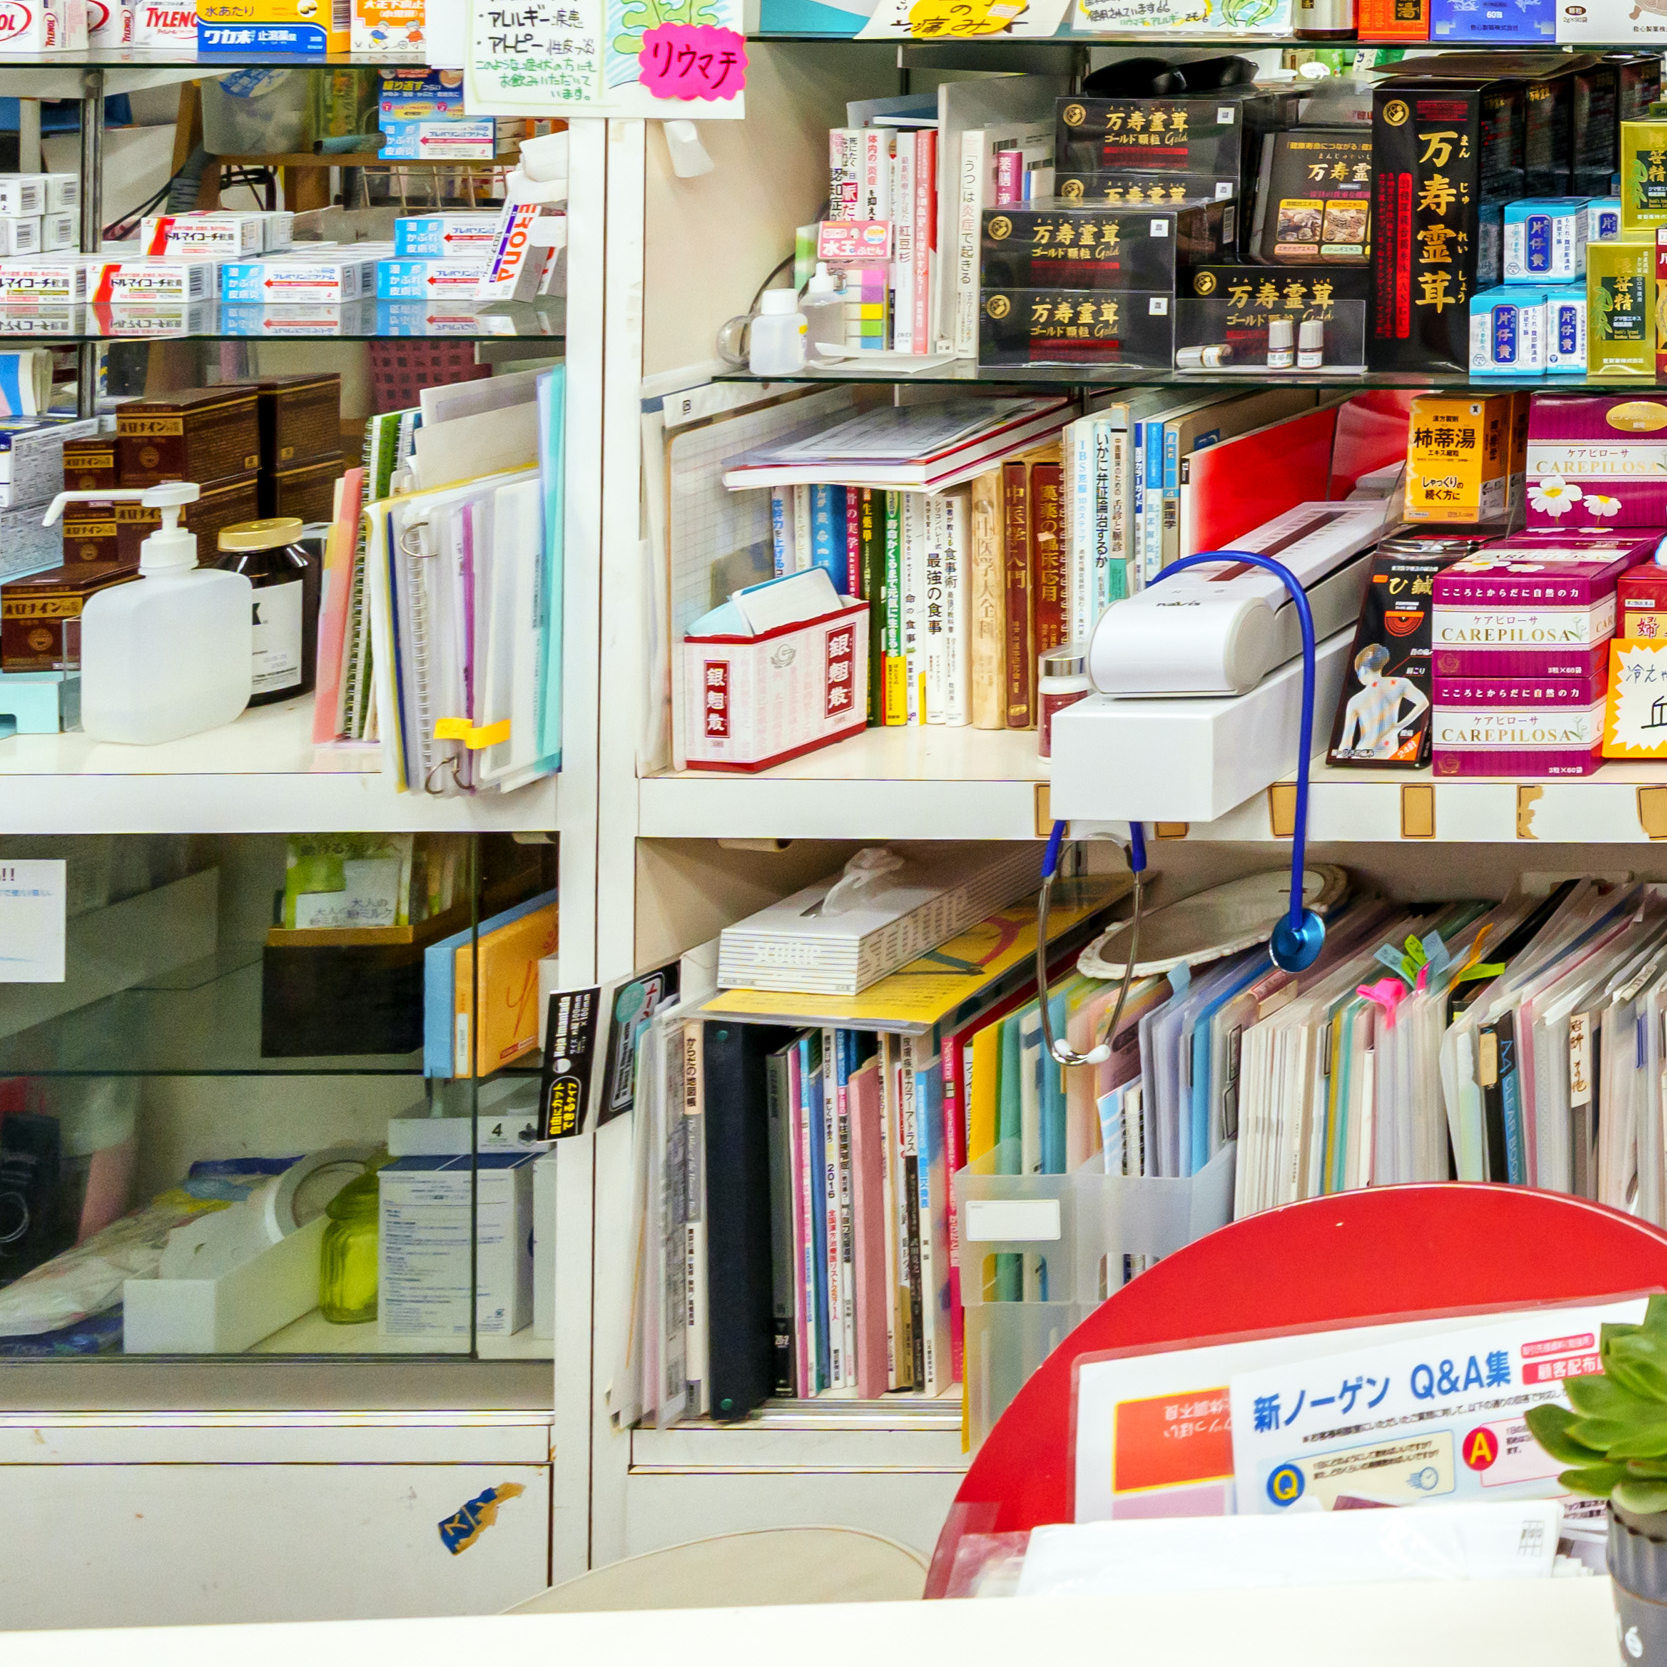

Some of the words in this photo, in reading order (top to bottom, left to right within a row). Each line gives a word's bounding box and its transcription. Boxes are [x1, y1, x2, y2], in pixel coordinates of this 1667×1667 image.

[652, 41, 738, 90] リウマチ
[1415, 131, 1459, 313] 万寿霊茸
[1441, 627, 1574, 643] CAREPILOSA
[1254, 1375, 1391, 1434] 新ノーゲン
[1411, 1350, 1512, 1401] Q&A集
